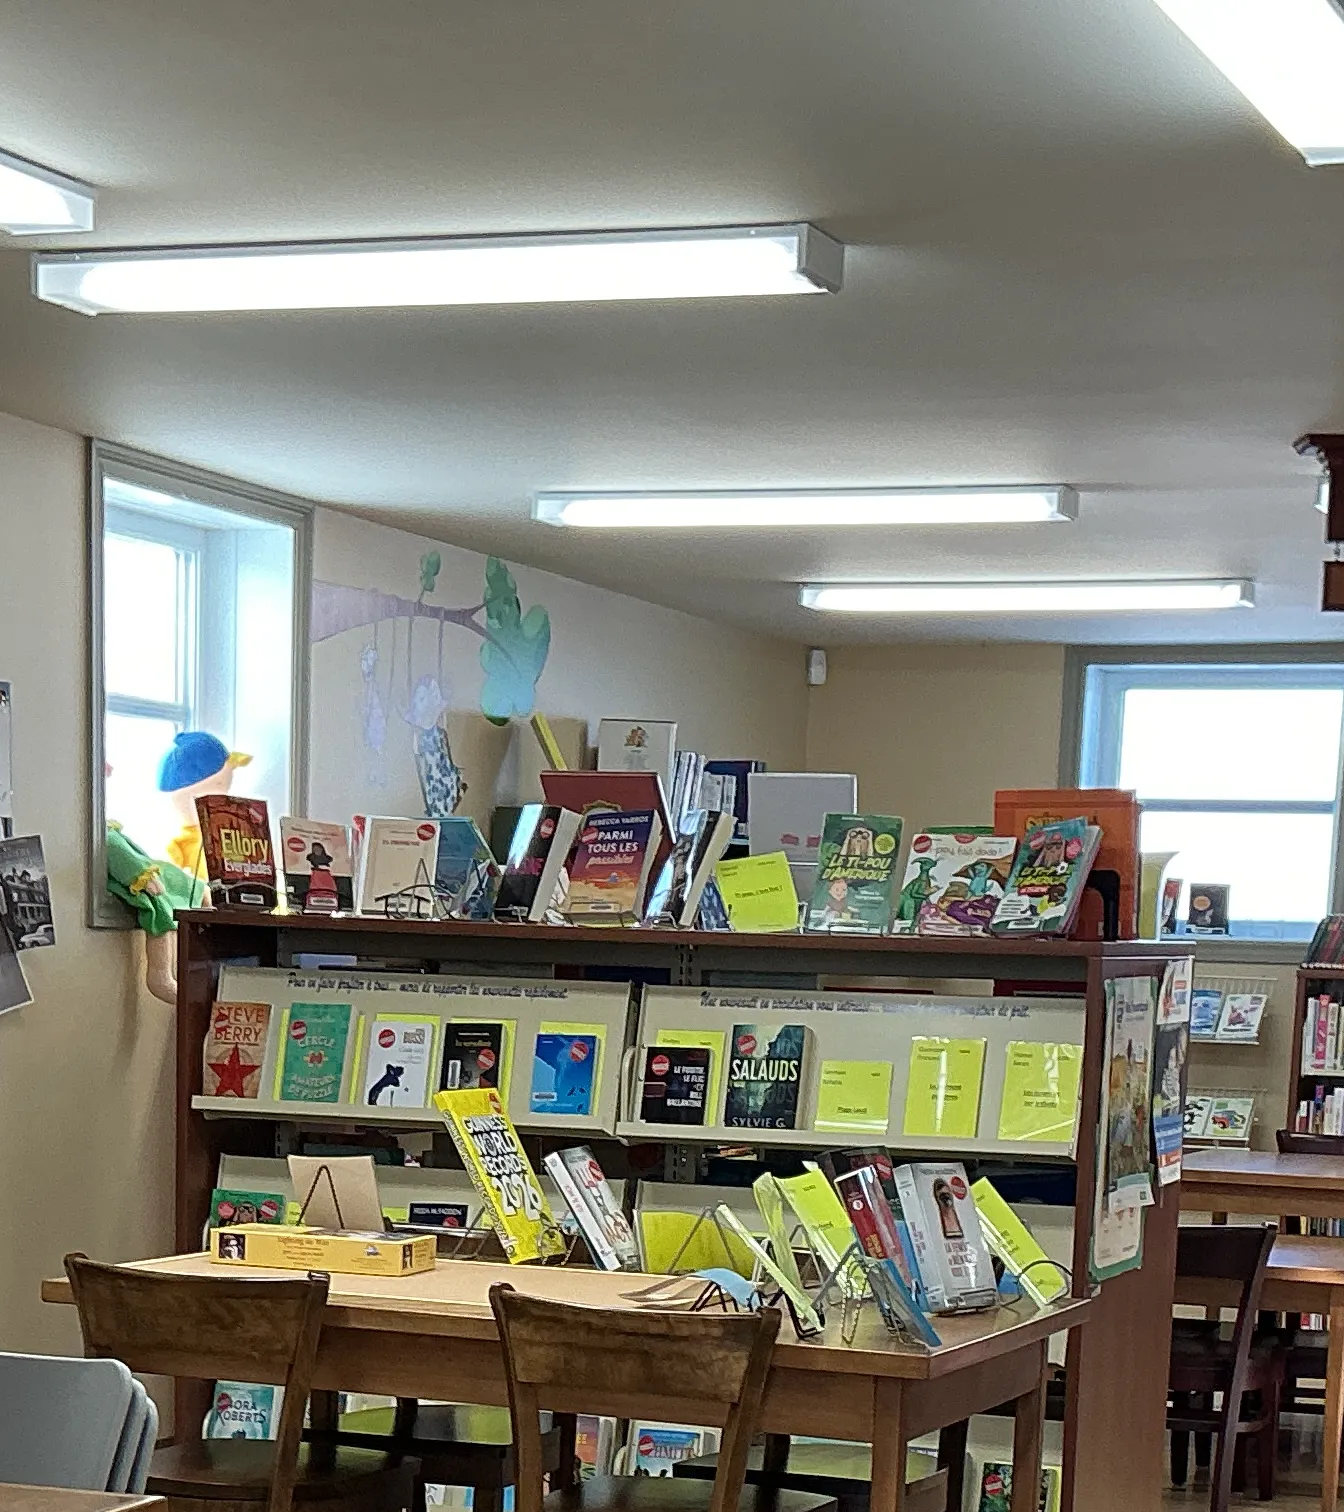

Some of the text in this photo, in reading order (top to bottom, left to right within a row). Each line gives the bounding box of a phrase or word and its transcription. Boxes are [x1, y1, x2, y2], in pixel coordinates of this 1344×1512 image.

[598, 829, 634, 841] PARMI
[220, 829, 269, 863] Ellory
[588, 841, 640, 854] TOUS LES
[216, 1006, 265, 1024] STEVE
[214, 1026, 263, 1043] BERRY
[731, 1058, 800, 1082] SALAUDS
[462, 1113, 509, 1134] GUINNESS
[731, 1116, 773, 1128] SYLVIE
[472, 1130, 518, 1158] WORLD
[478, 1152, 529, 1177] RECORDS
[491, 1172, 544, 1222] 2026
